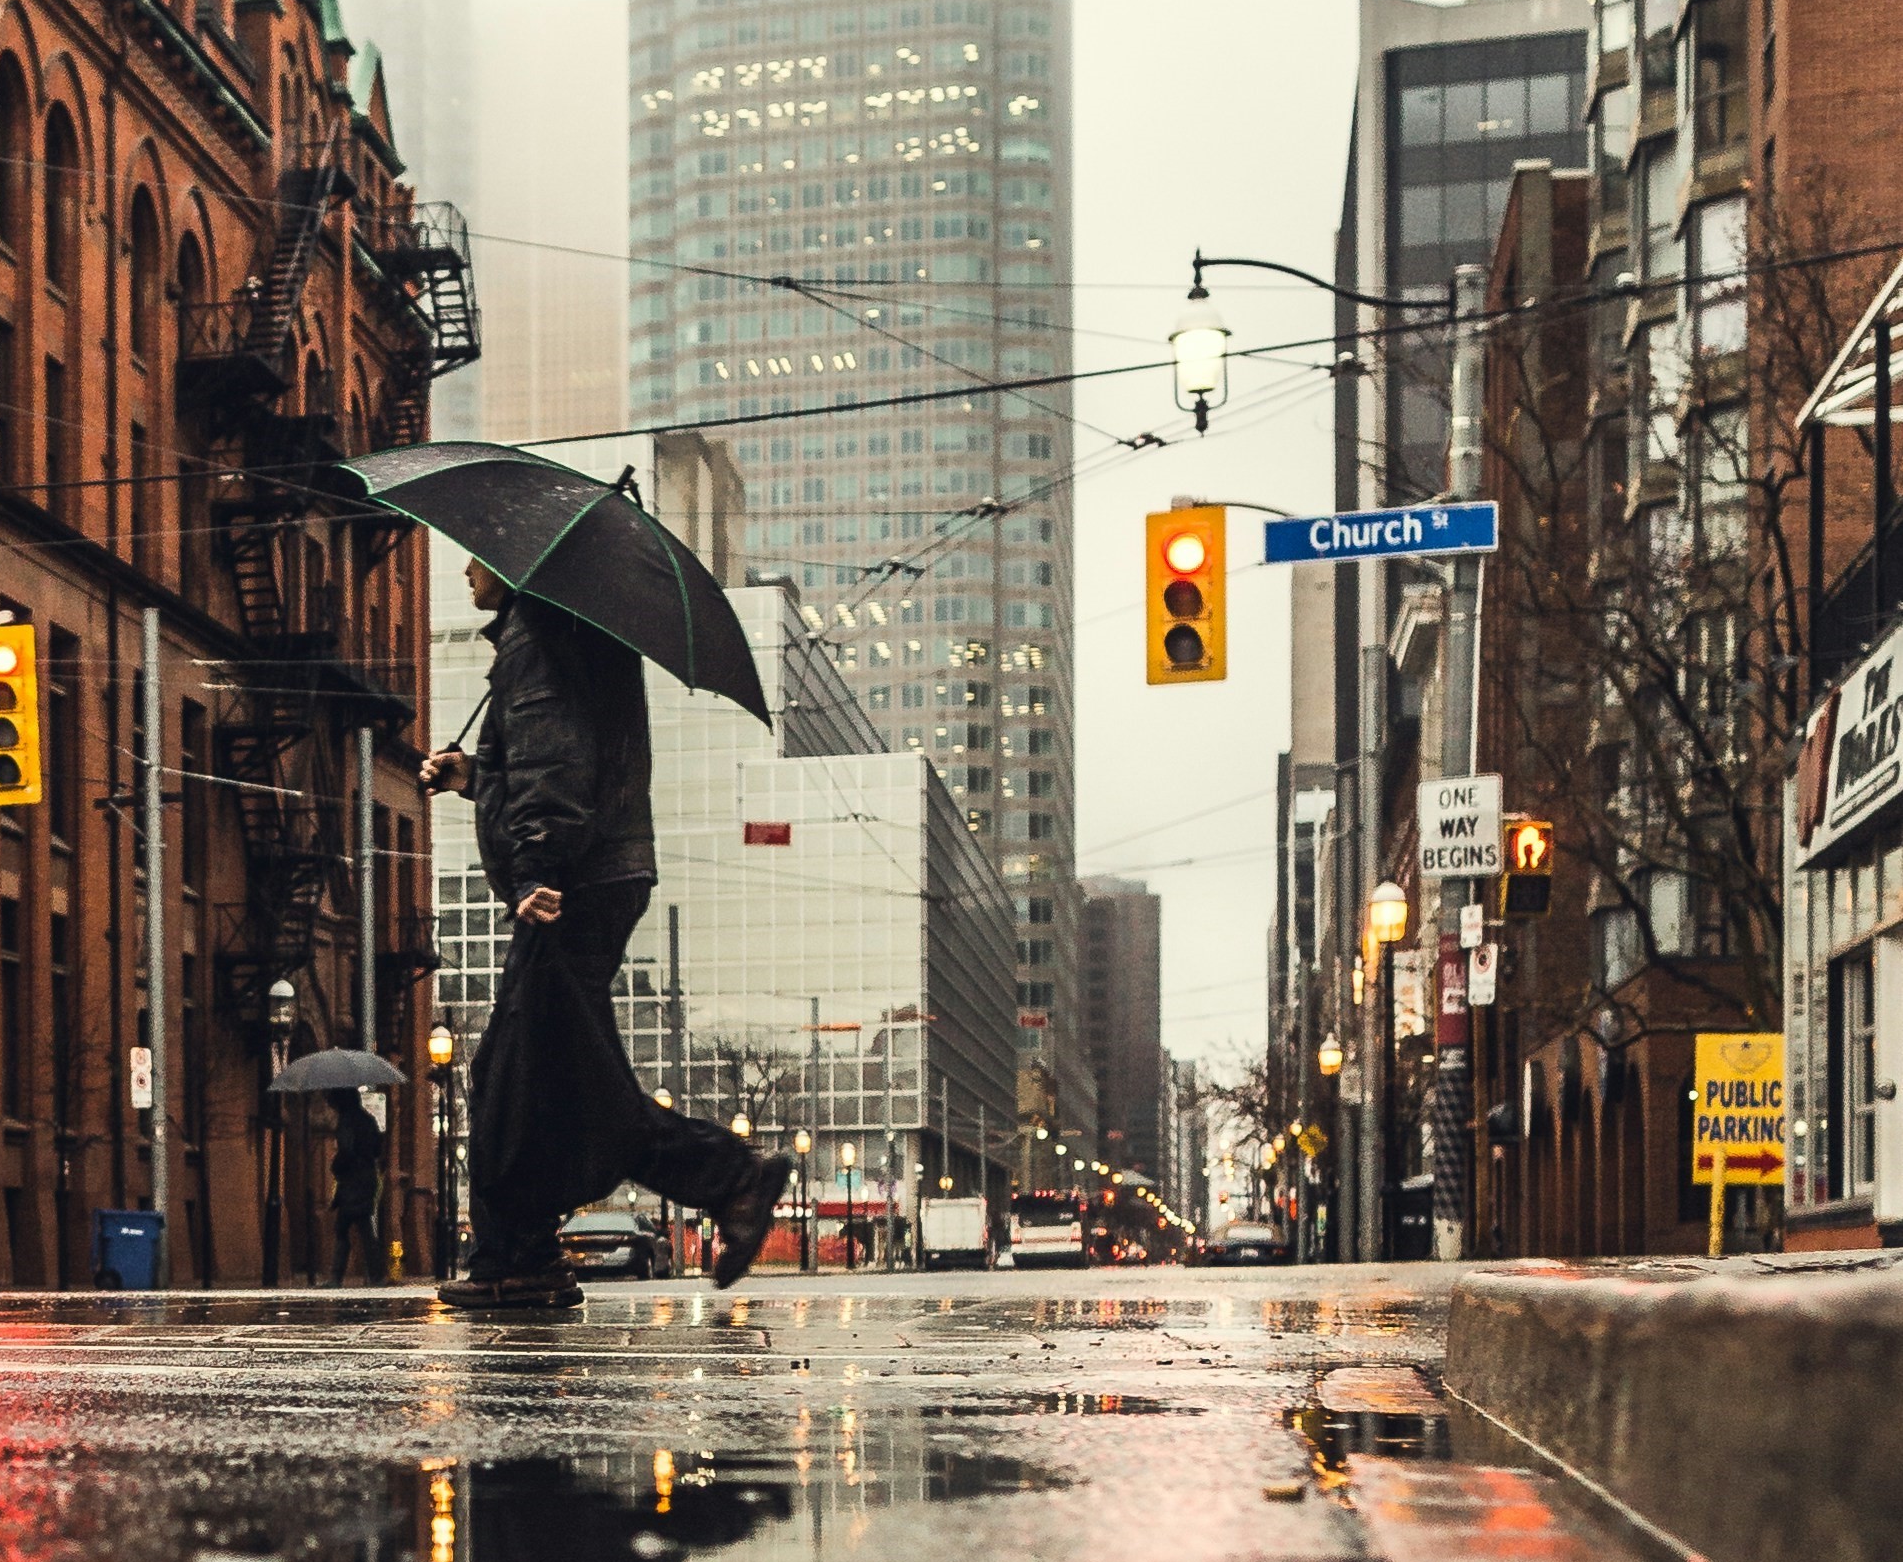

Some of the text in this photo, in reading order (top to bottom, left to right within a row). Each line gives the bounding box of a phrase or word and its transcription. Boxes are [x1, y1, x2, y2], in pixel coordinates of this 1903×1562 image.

[1309, 513, 1423, 551] Church
[1439, 784, 1480, 809] ONE
[1439, 814, 1480, 839] WAY
[1422, 843, 1497, 870] BEGINS
[1705, 1079, 1783, 1109] PUBLIC
